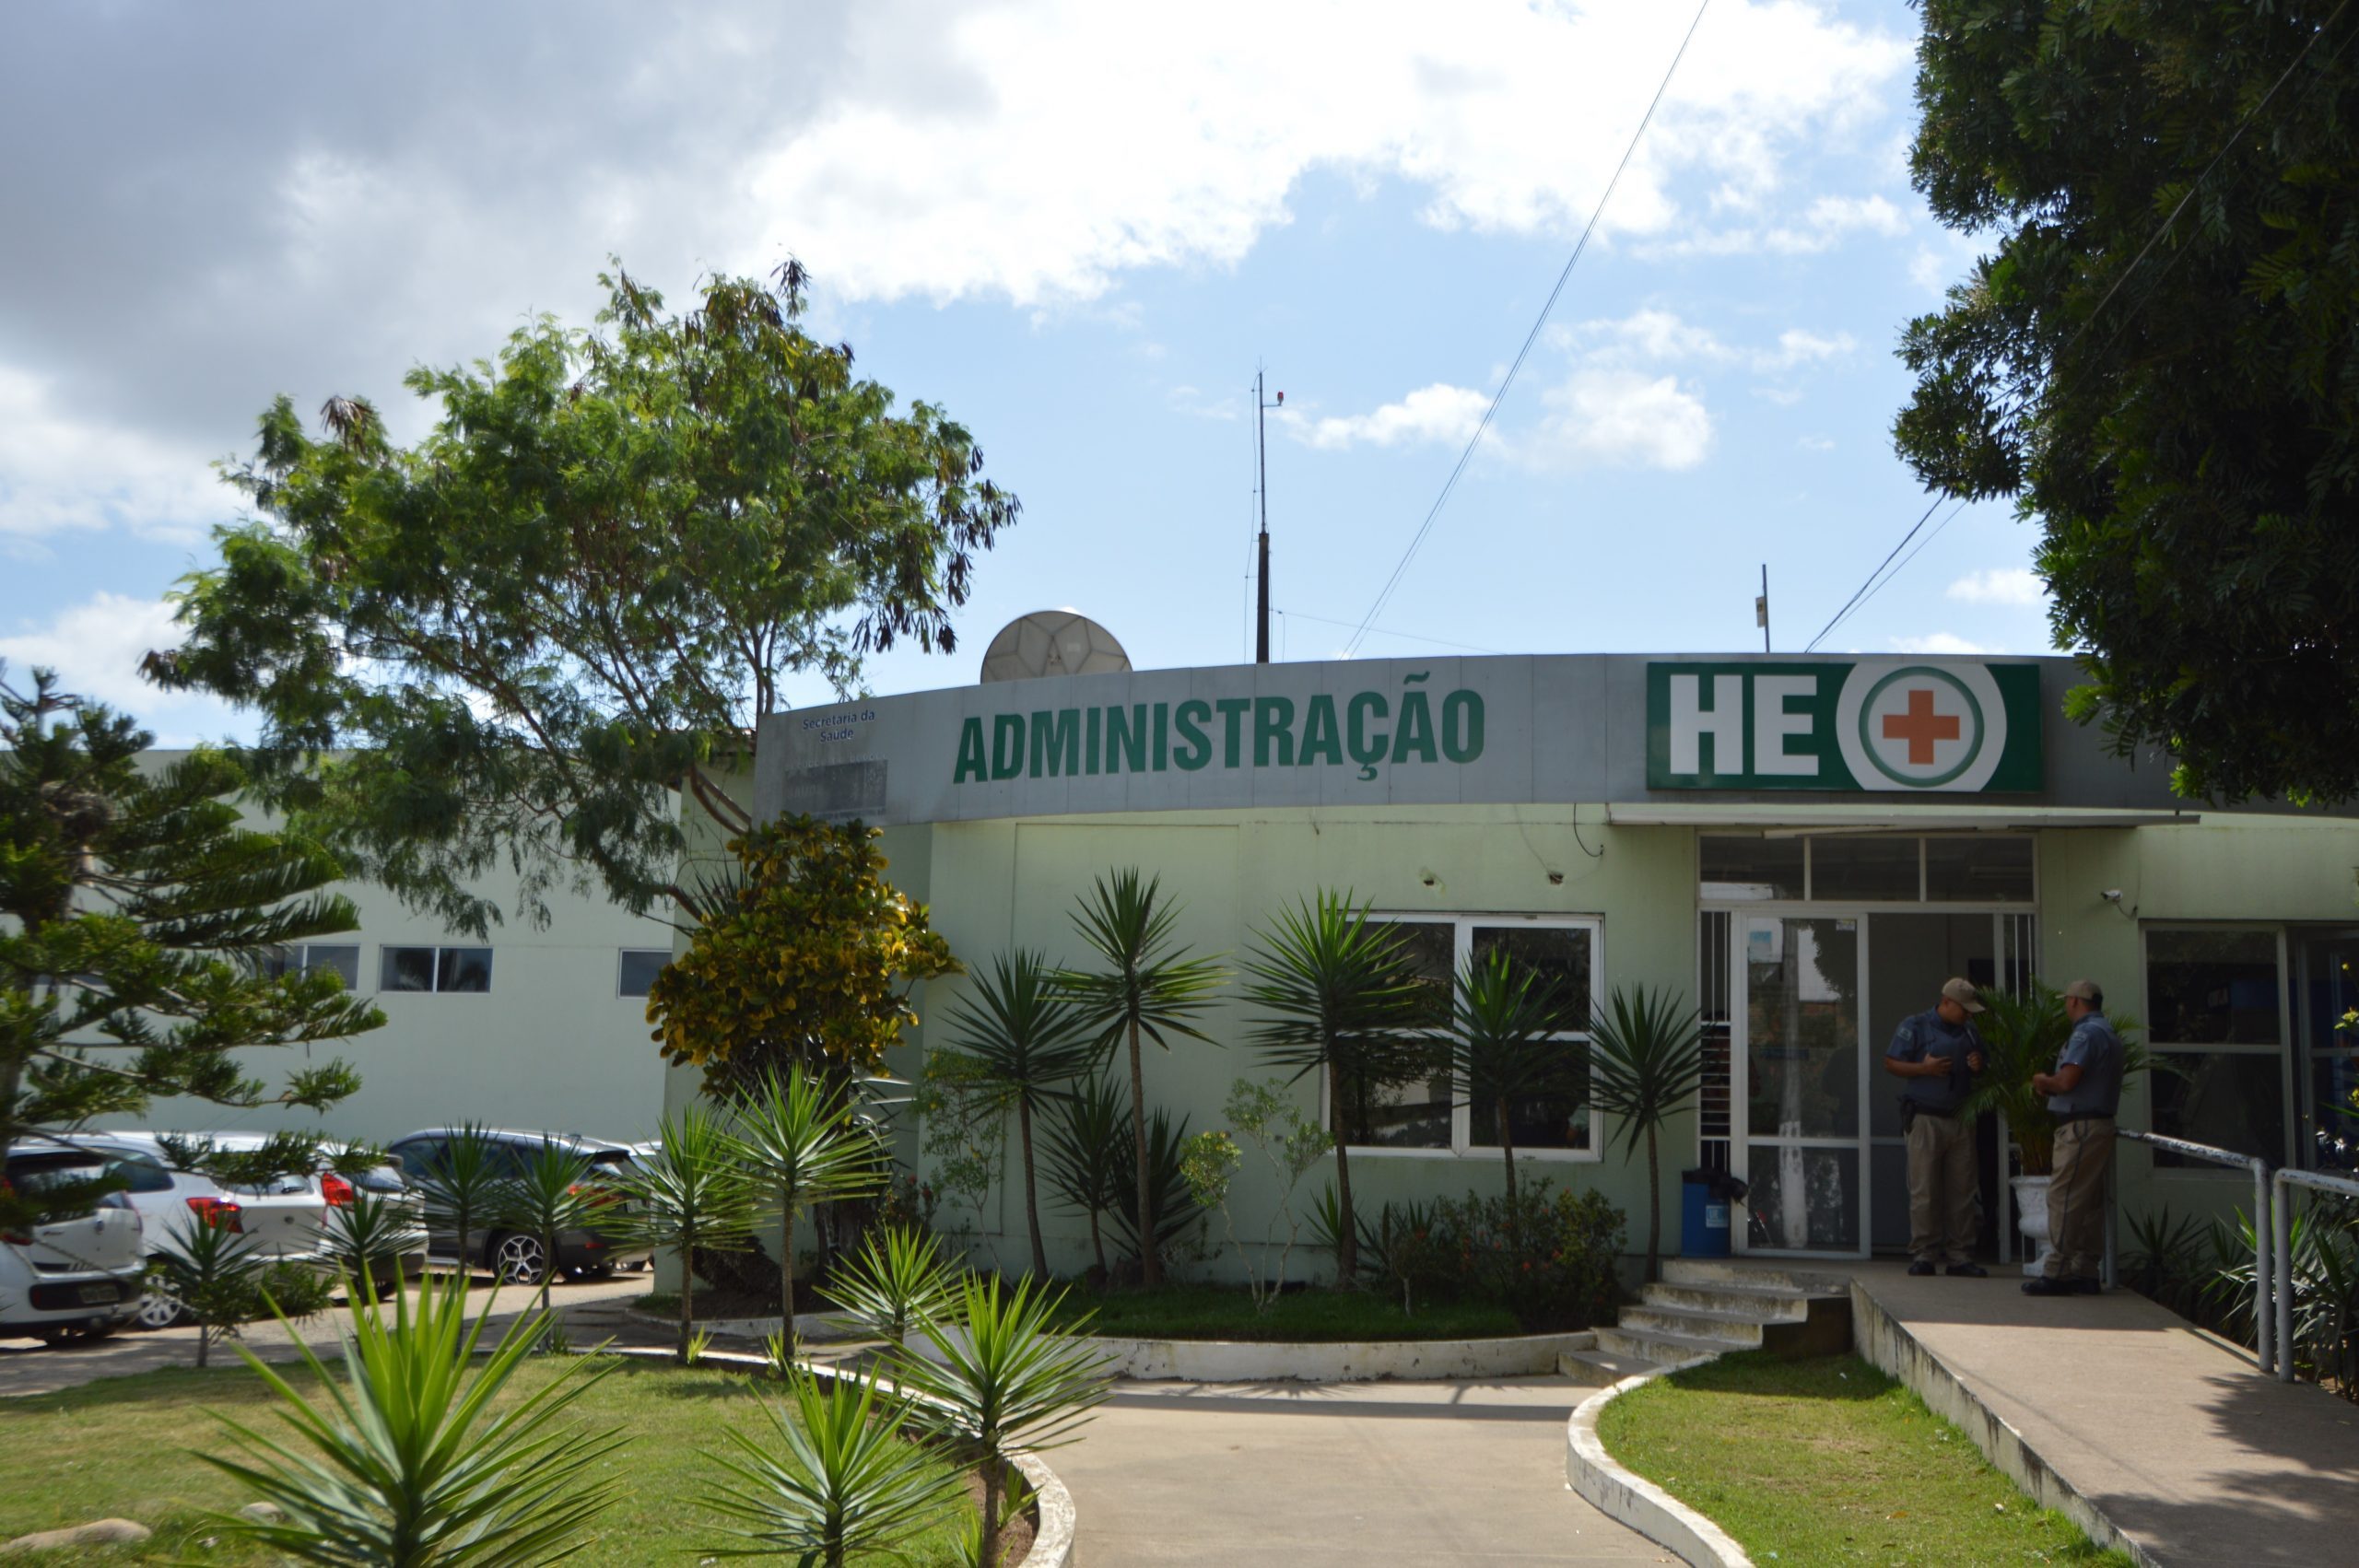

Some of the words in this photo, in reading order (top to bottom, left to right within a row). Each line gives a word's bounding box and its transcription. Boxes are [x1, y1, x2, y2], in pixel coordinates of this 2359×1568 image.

[803, 711, 857, 730] Secretaria
[861, 709, 875, 721] da
[953, 671, 1485, 783] ADMINISTRAÇÃO
